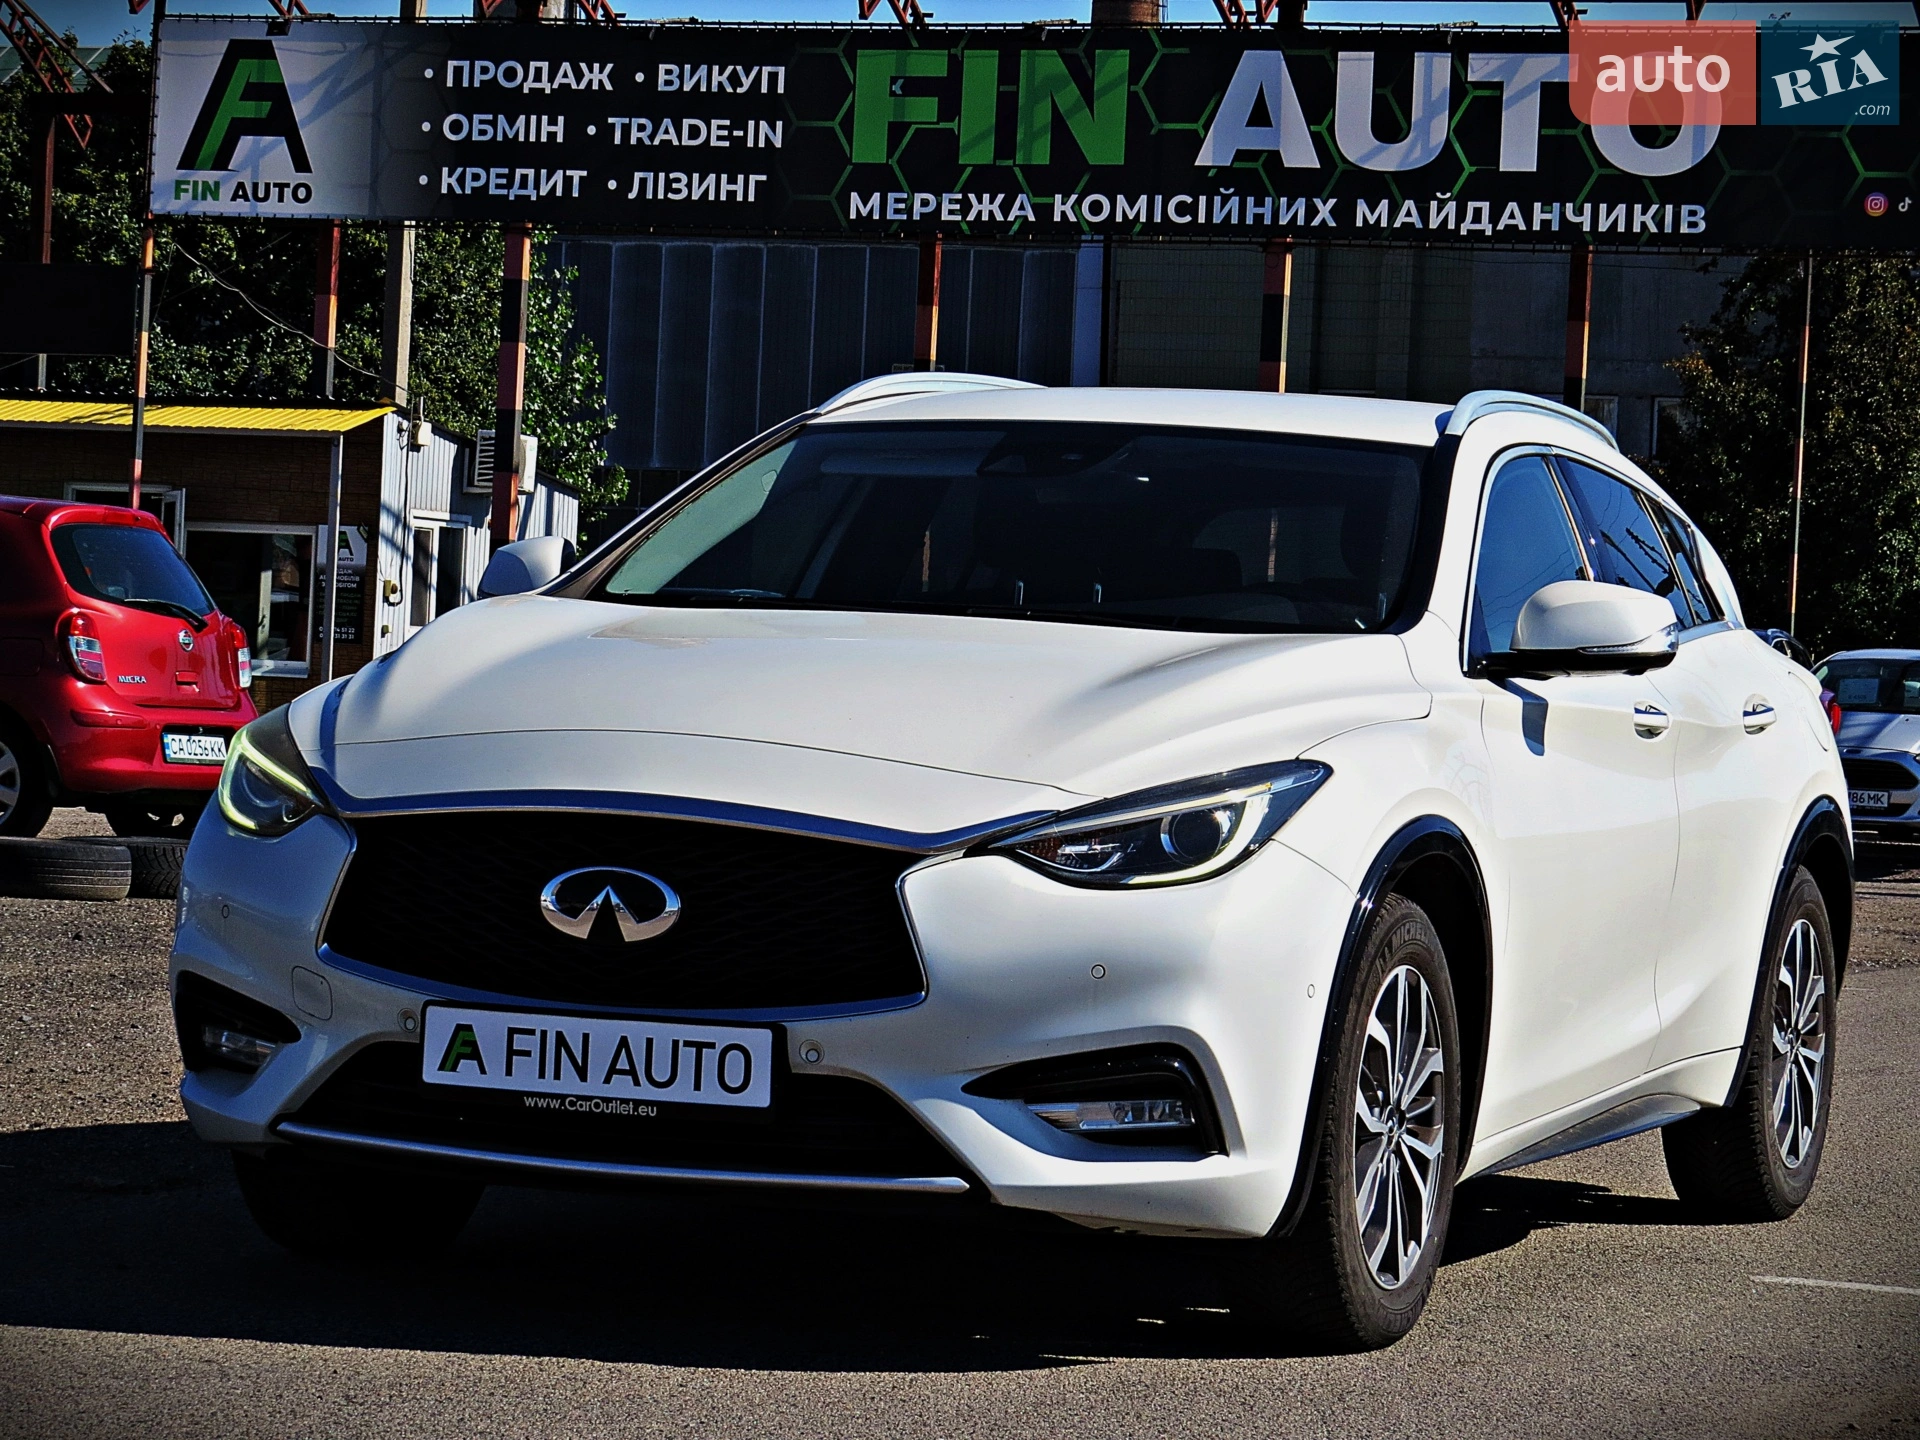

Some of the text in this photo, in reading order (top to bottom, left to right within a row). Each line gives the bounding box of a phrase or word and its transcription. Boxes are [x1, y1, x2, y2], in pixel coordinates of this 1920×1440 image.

[445, 59, 786, 94] ПРОДАЖ ВИКУП
[442, 113, 783, 149] ОБМІН TRADE-IN
[851, 49, 1723, 178] FIN AUTO
[173, 180, 314, 204] FIN AUTO
[440, 166, 768, 202] КРЕДИТ ЛІЗИНГ
[849, 187, 1708, 236] МЕРЕЖА КОМІСІЙНИХ МАЙДАНЧИКІВ
[118, 675, 147, 683] MICRA
[1848, 791, 1865, 804] 86
[504, 1026, 591, 1083] FIN
[602, 1035, 753, 1095] AUTO
[523, 1096, 658, 1117] www.CarOutlet.eu
